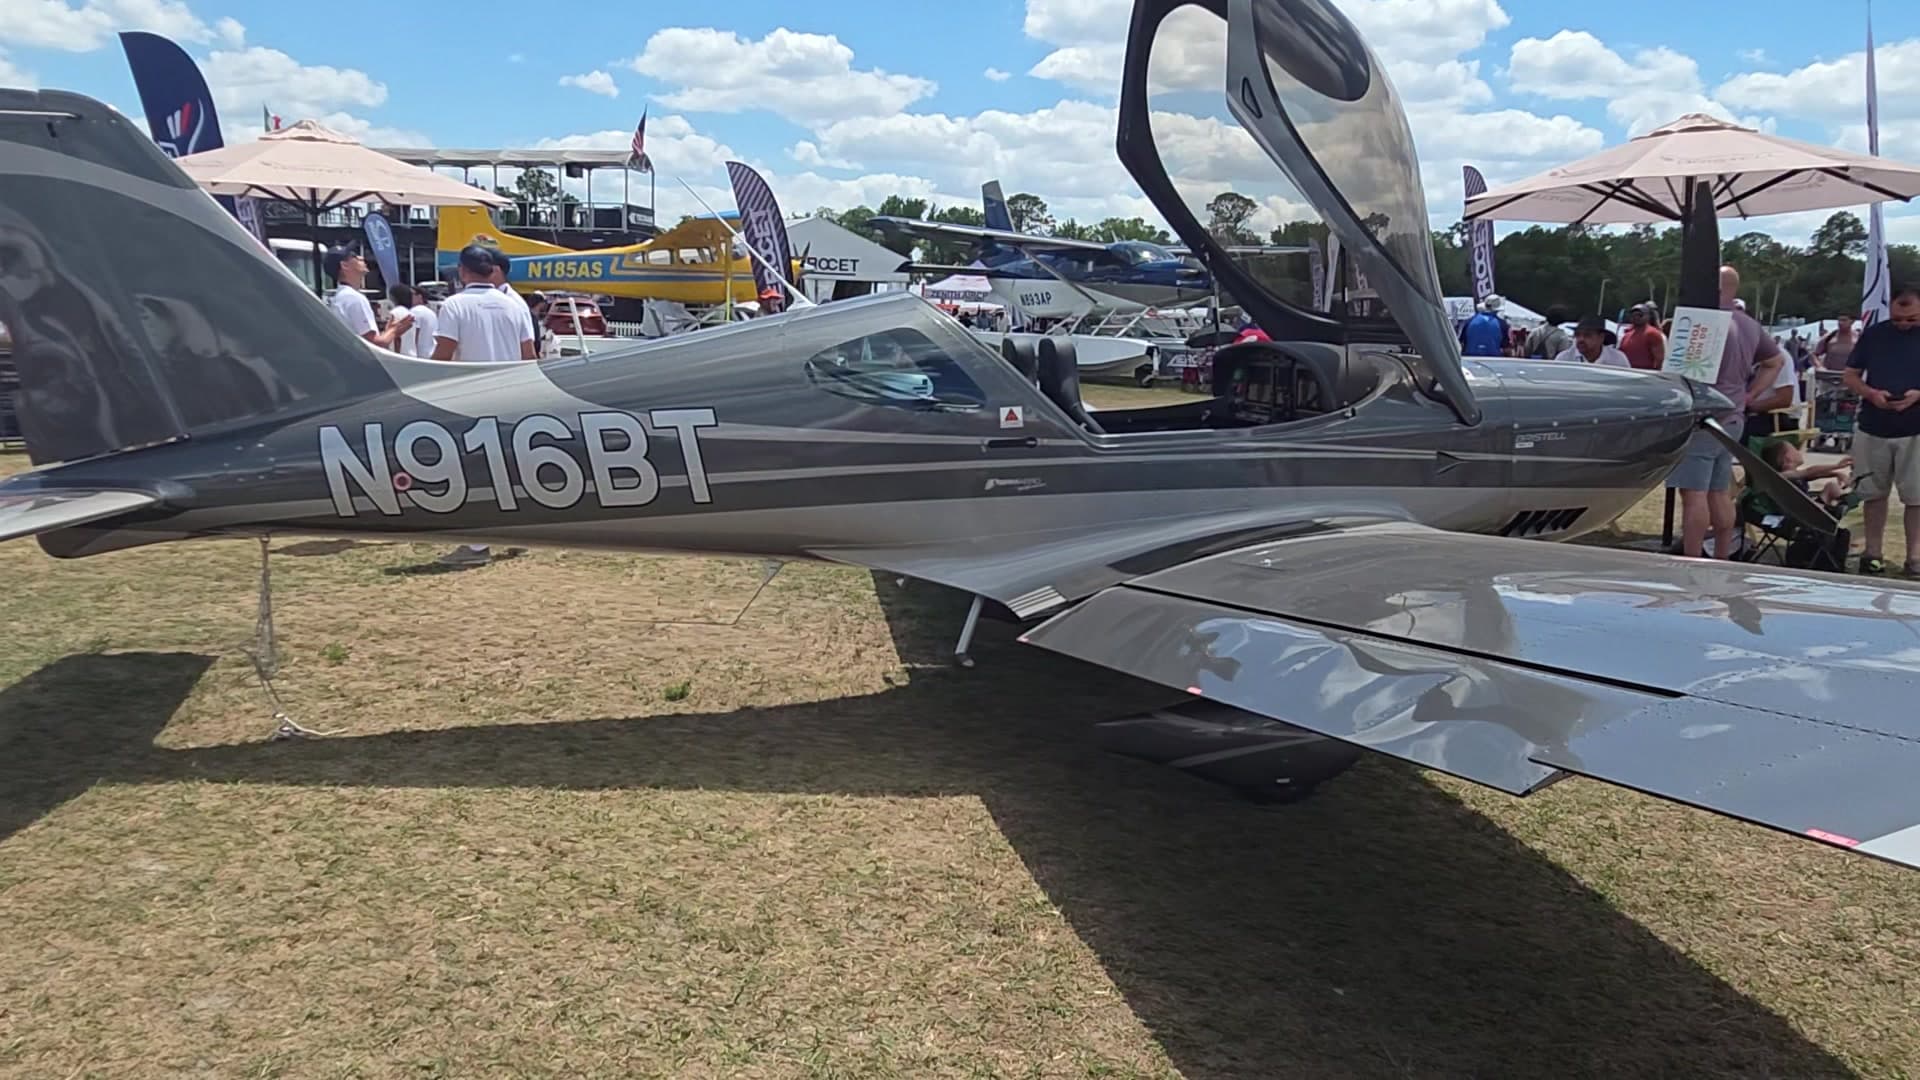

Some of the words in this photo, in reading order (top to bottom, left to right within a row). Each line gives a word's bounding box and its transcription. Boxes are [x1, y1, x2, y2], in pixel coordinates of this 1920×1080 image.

[527, 261, 603, 279] N185AS
[747, 207, 784, 290] ROCET
[806, 256, 860, 272] ROCET
[1472, 219, 1492, 299] ROCE
[318, 406, 719, 518] N916BT
